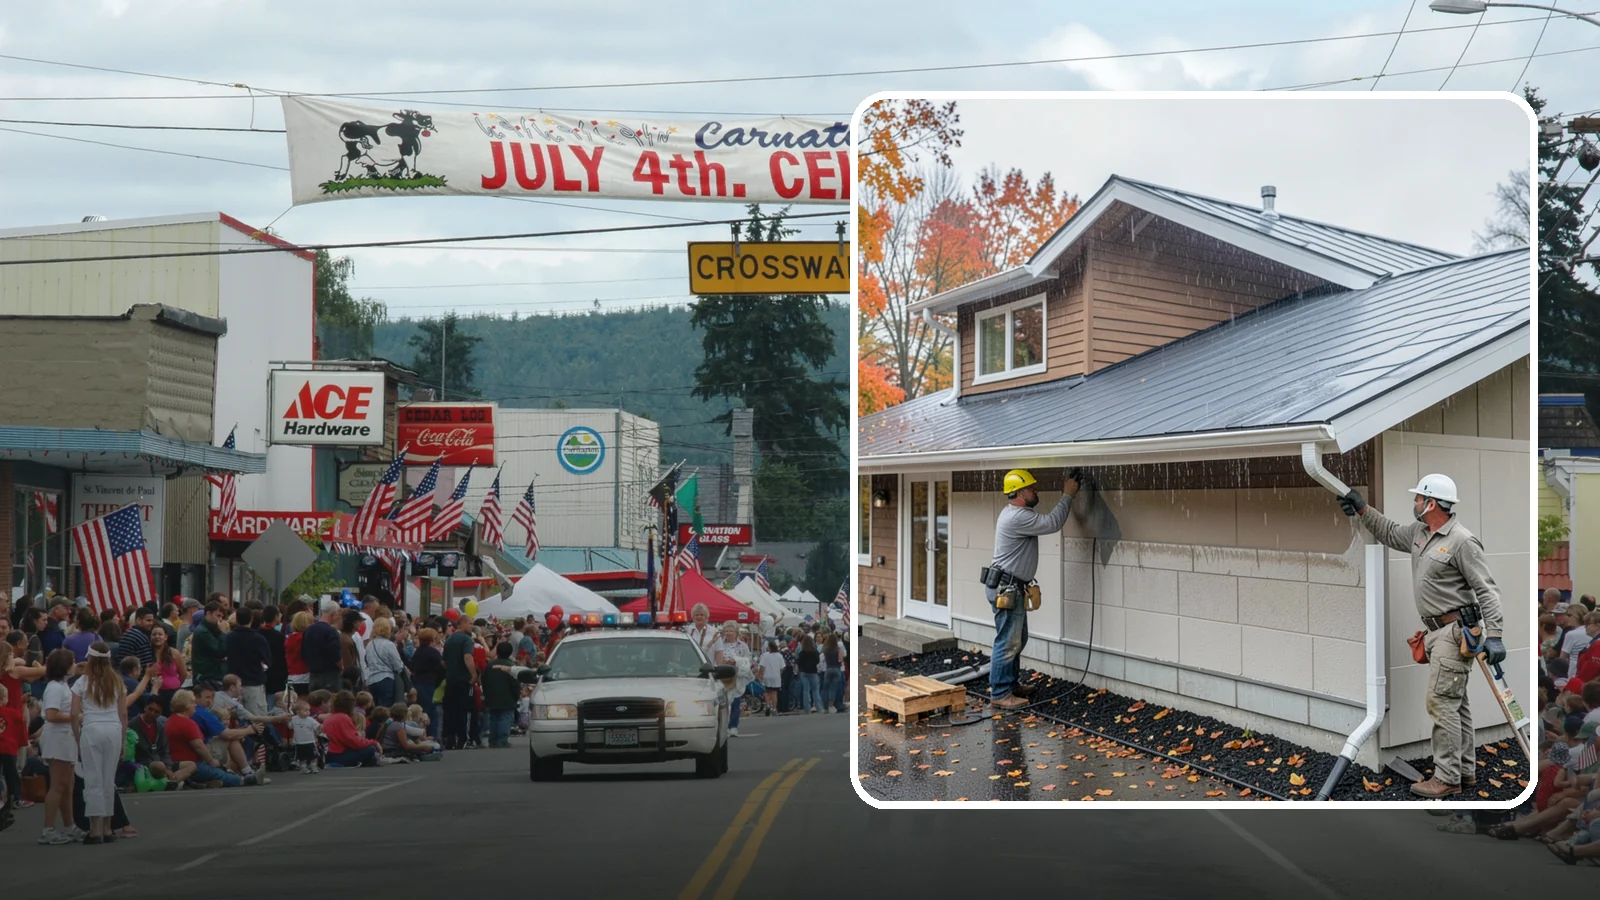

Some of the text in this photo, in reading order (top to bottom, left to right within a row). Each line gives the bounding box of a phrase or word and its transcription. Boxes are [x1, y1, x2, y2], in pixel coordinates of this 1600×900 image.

[695, 121, 850, 150] Carnat
[481, 141, 605, 192] JULY
[632, 150, 747, 198] 4th.
[696, 254, 850, 280] CROSSWA
[283, 380, 373, 420] ACE
[405, 408, 485, 422] CEDAR LOG
[283, 420, 371, 437] Hardware
[416, 428, 477, 447] Coca-Cola
[353, 467, 387, 480] Simpl
[83, 485, 155, 495] St. Vincent de Paul
[688, 526, 741, 535] CRNATION
[699, 535, 730, 543] GLASS
